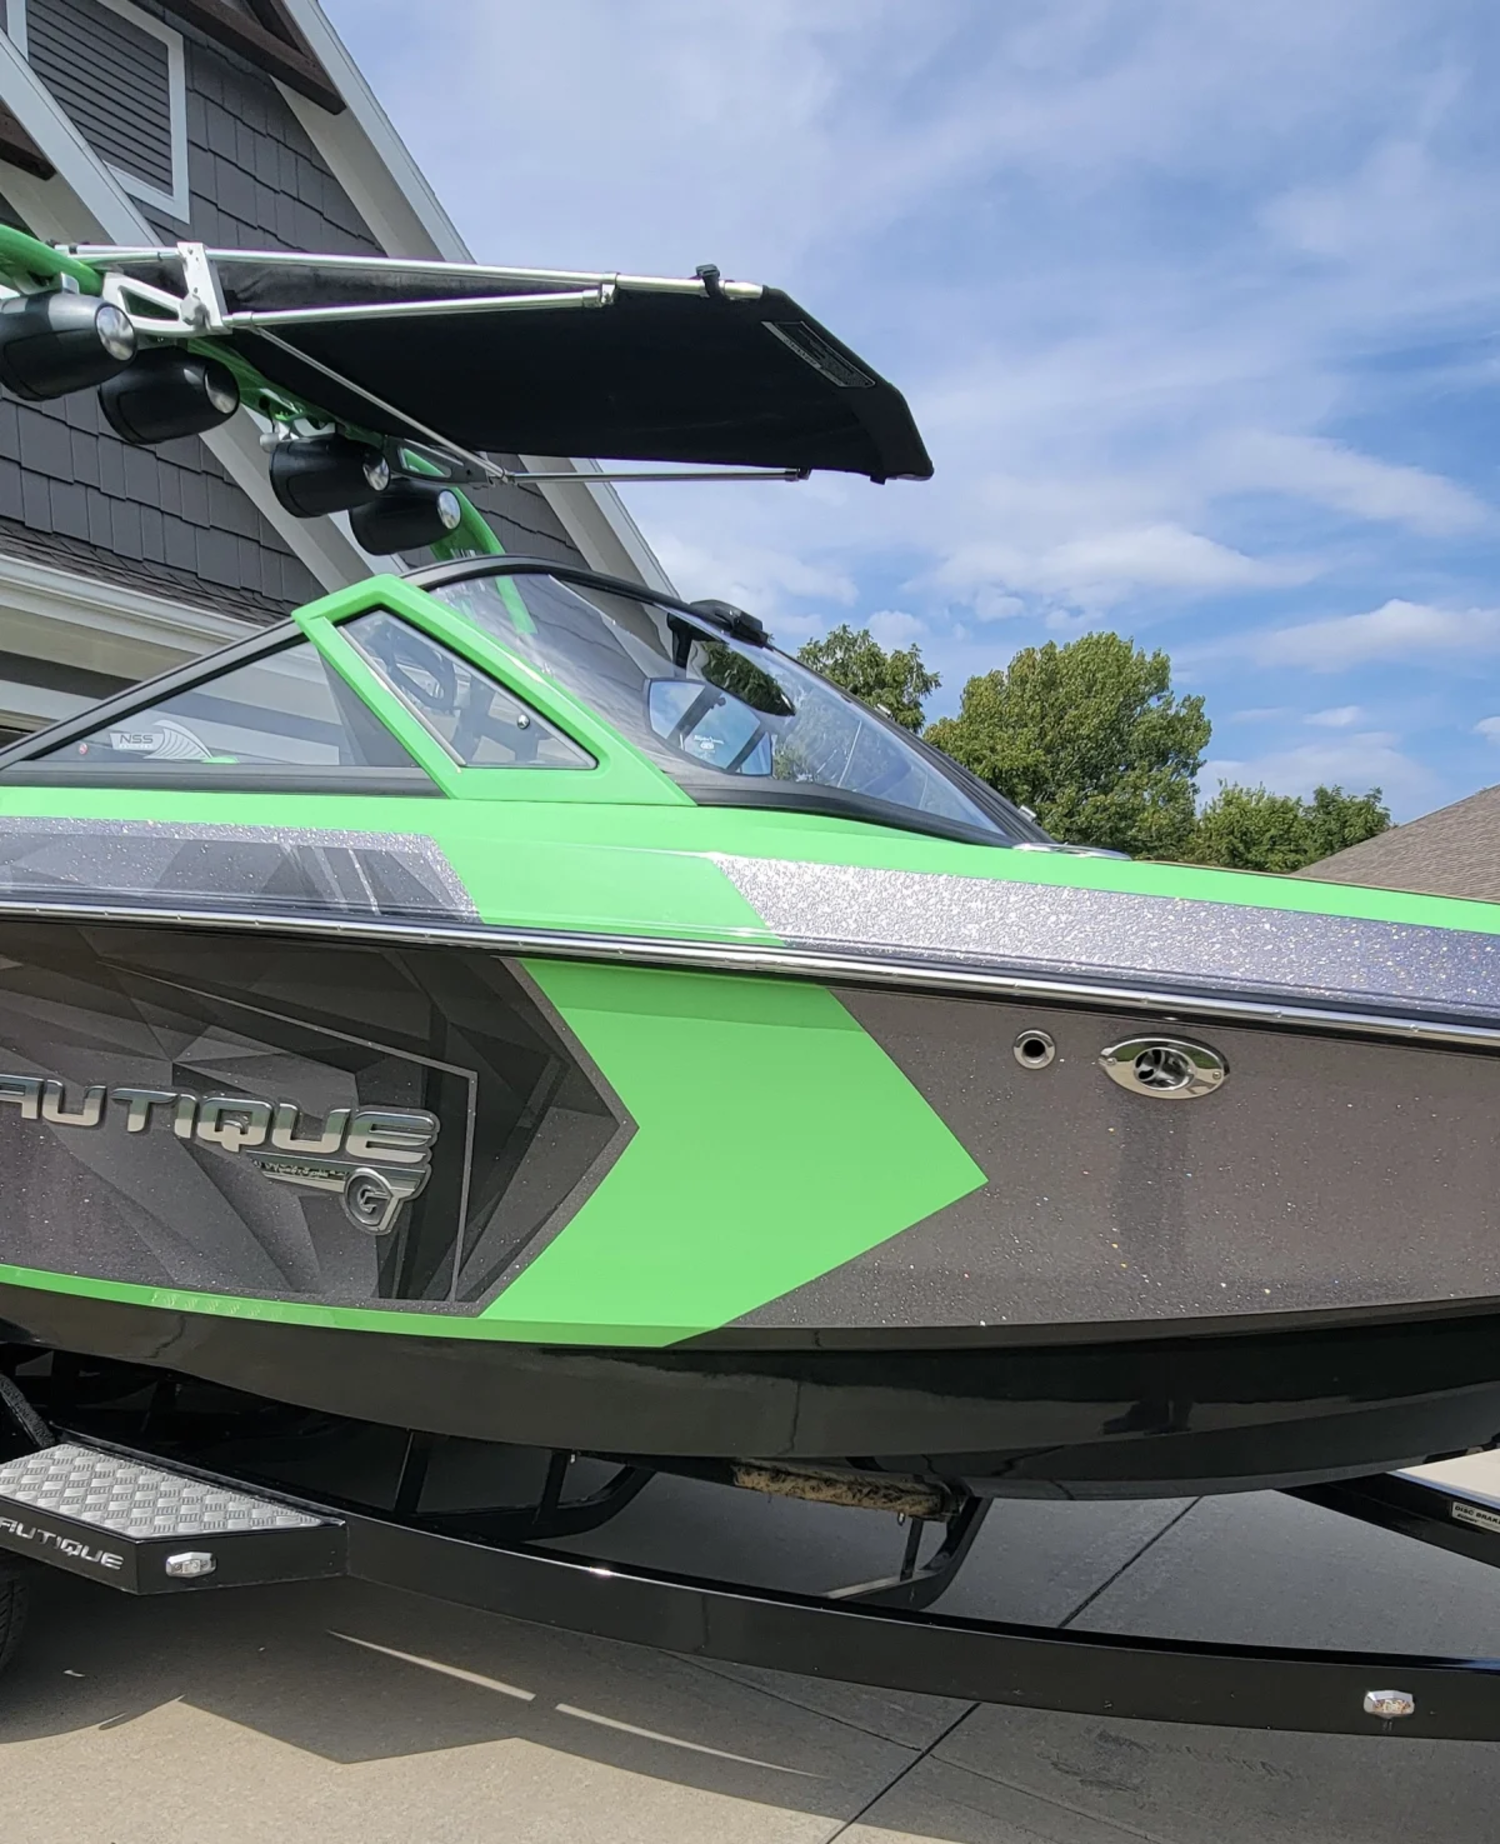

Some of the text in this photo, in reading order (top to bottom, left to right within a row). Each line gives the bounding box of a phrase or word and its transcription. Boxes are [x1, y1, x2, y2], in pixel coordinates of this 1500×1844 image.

[119, 734, 154, 744] NSS
[1454, 1505, 1475, 1516] DISC
[1475, 1511, 1500, 1525] BRAK
